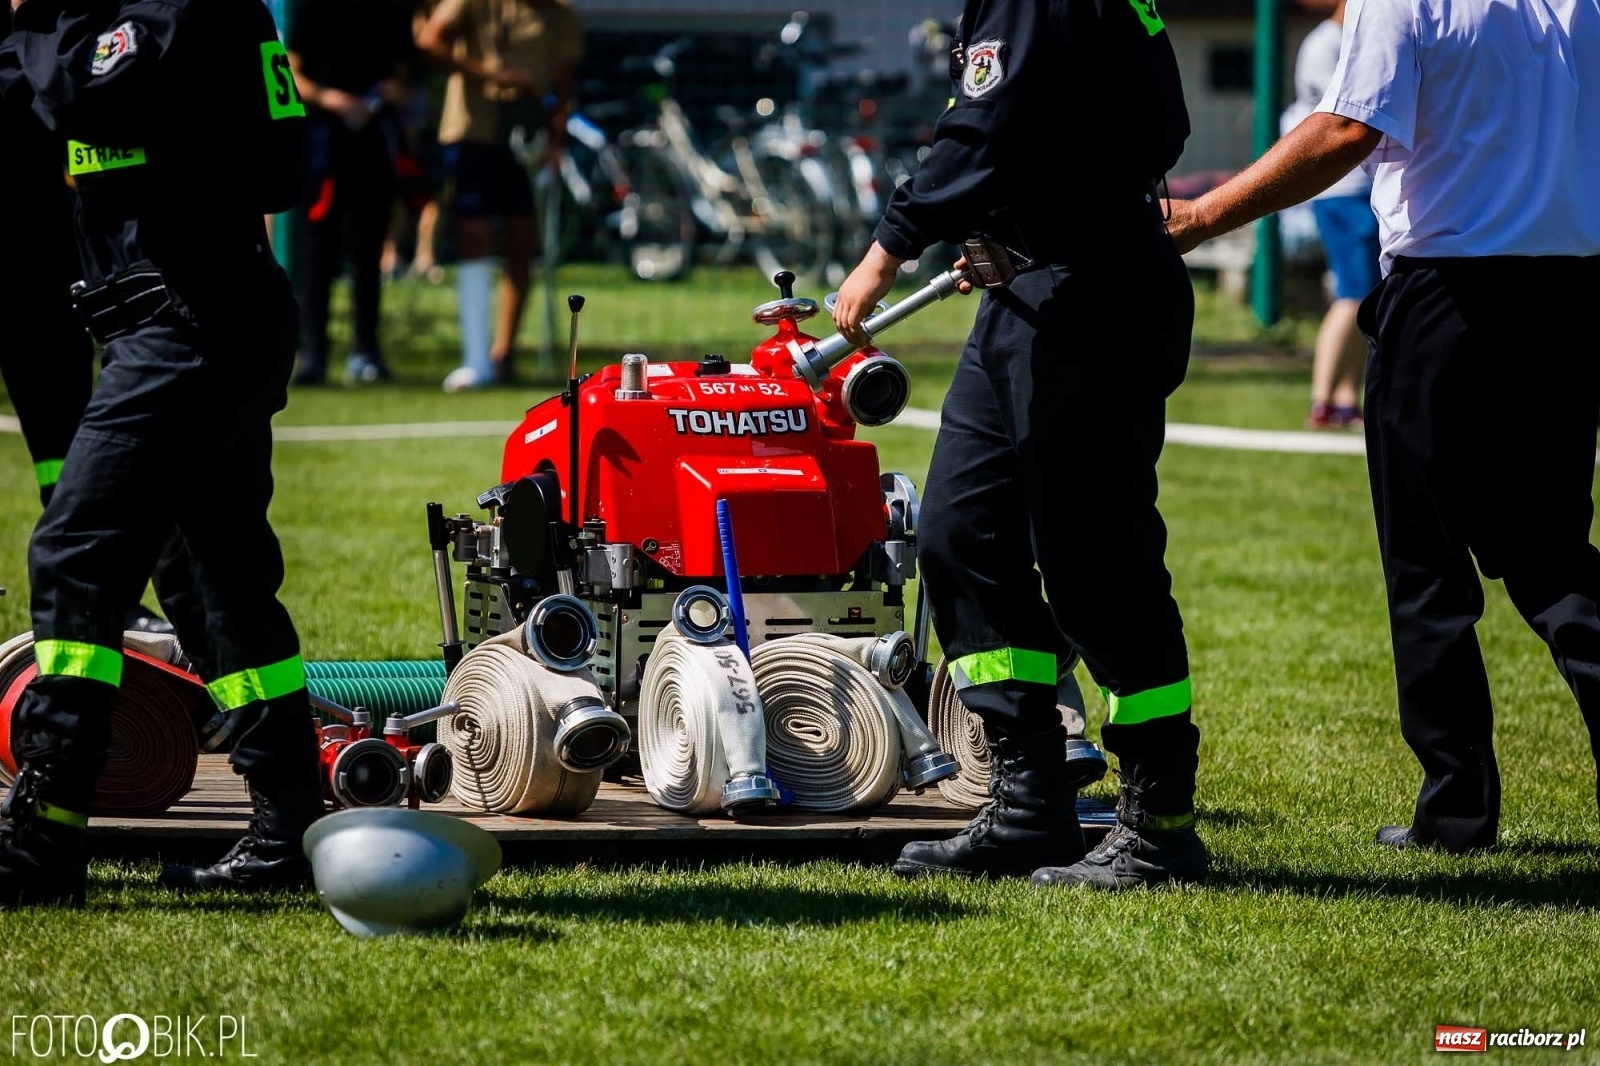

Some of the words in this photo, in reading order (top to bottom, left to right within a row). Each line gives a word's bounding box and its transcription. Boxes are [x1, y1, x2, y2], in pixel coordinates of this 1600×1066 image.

[699, 382, 736, 395] 567
[758, 382, 789, 396] 52
[667, 407, 808, 436] TOHATSU
